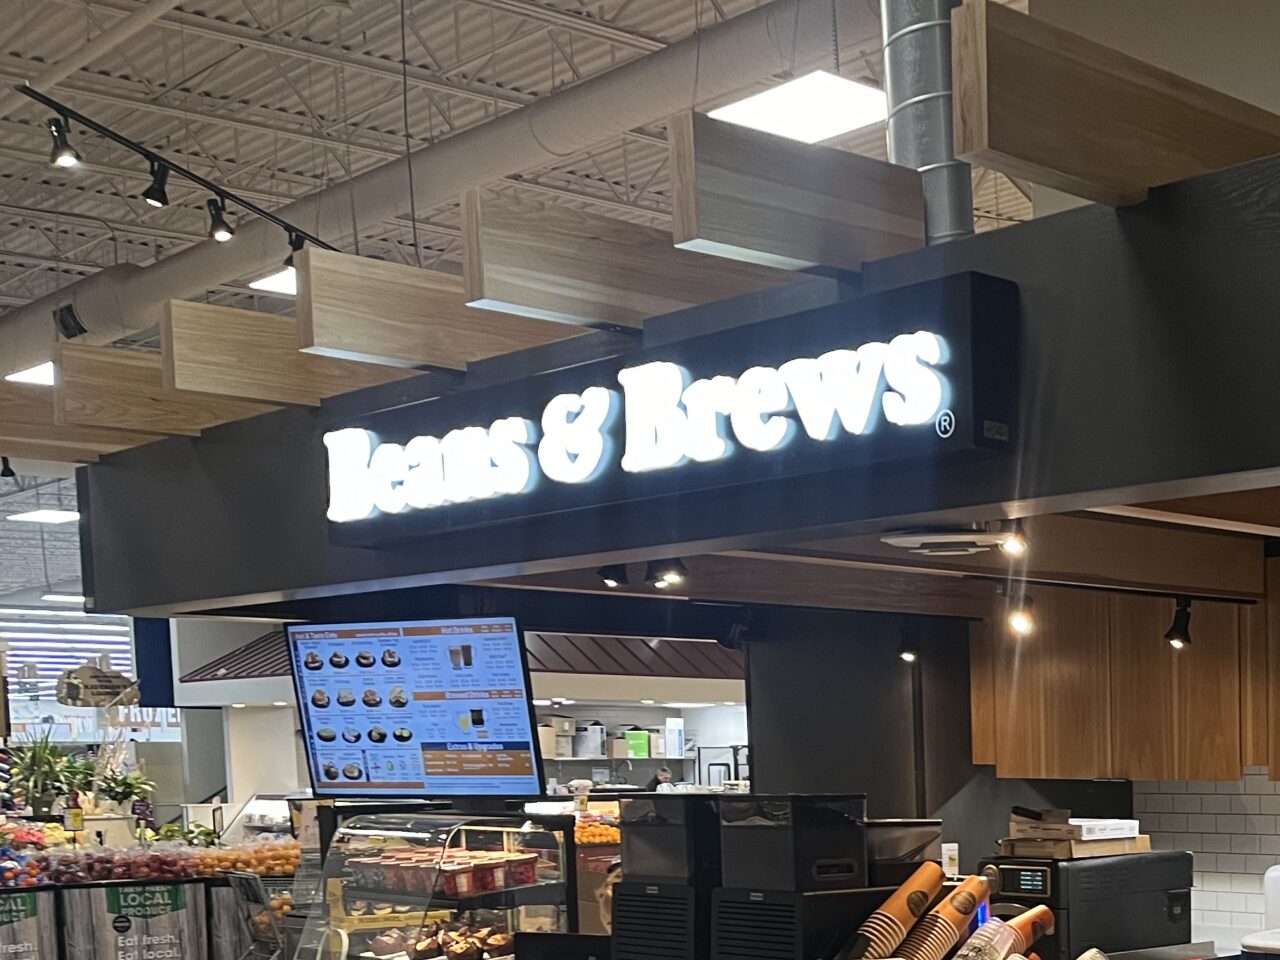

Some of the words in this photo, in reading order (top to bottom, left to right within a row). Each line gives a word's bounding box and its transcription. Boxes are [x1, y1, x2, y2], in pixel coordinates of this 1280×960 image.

[323, 415, 530, 523] Beans
[539, 386, 618, 485] &
[617, 330, 952, 473] Brews
[119, 892, 172, 906] LOCAL
[121, 905, 171, 915] PRODUCE
[117, 936, 139, 947] Eat
[142, 934, 179, 945] fresh.
[142, 947, 182, 960] local.
